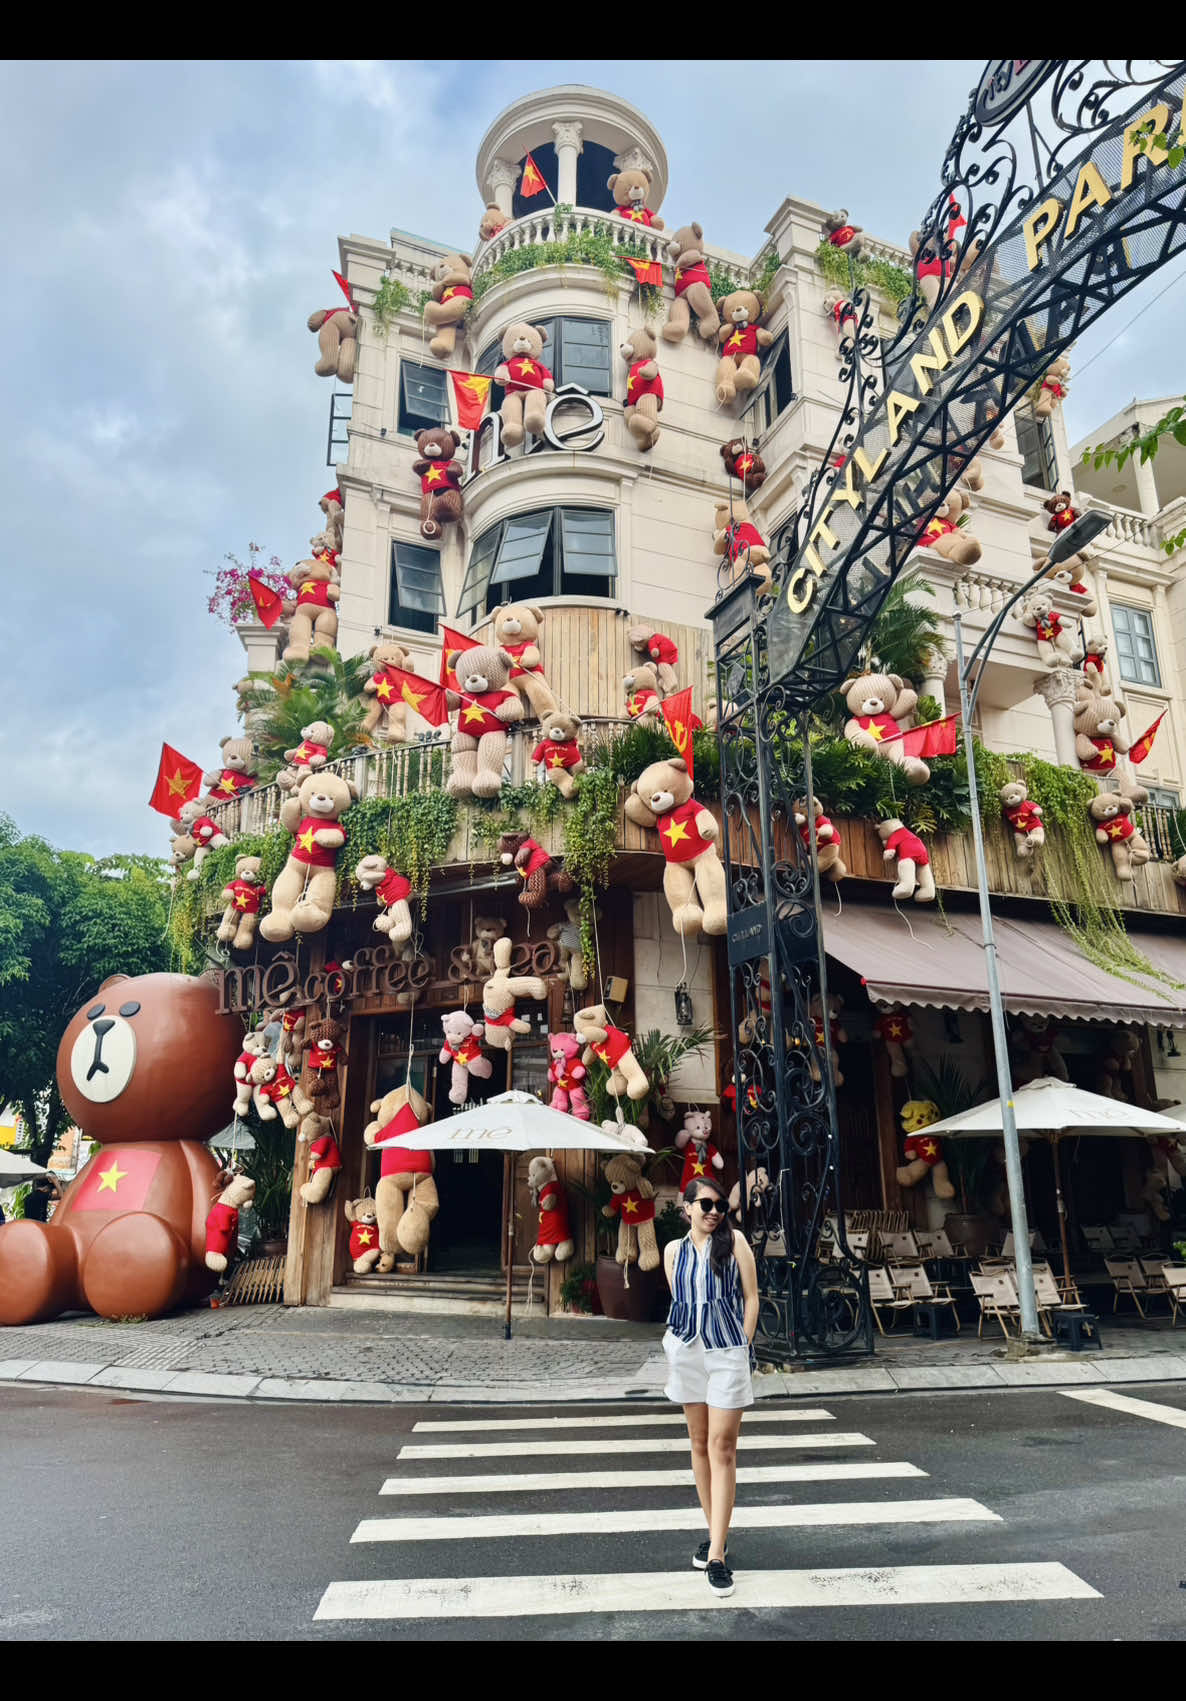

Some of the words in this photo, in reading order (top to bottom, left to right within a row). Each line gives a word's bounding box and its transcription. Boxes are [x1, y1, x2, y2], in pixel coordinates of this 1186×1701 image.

[787, 290, 984, 615] CITYLAND
[1022, 83, 1186, 272] PAR
[214, 951, 300, 1016] mê
[303, 944, 430, 1002] coffee
